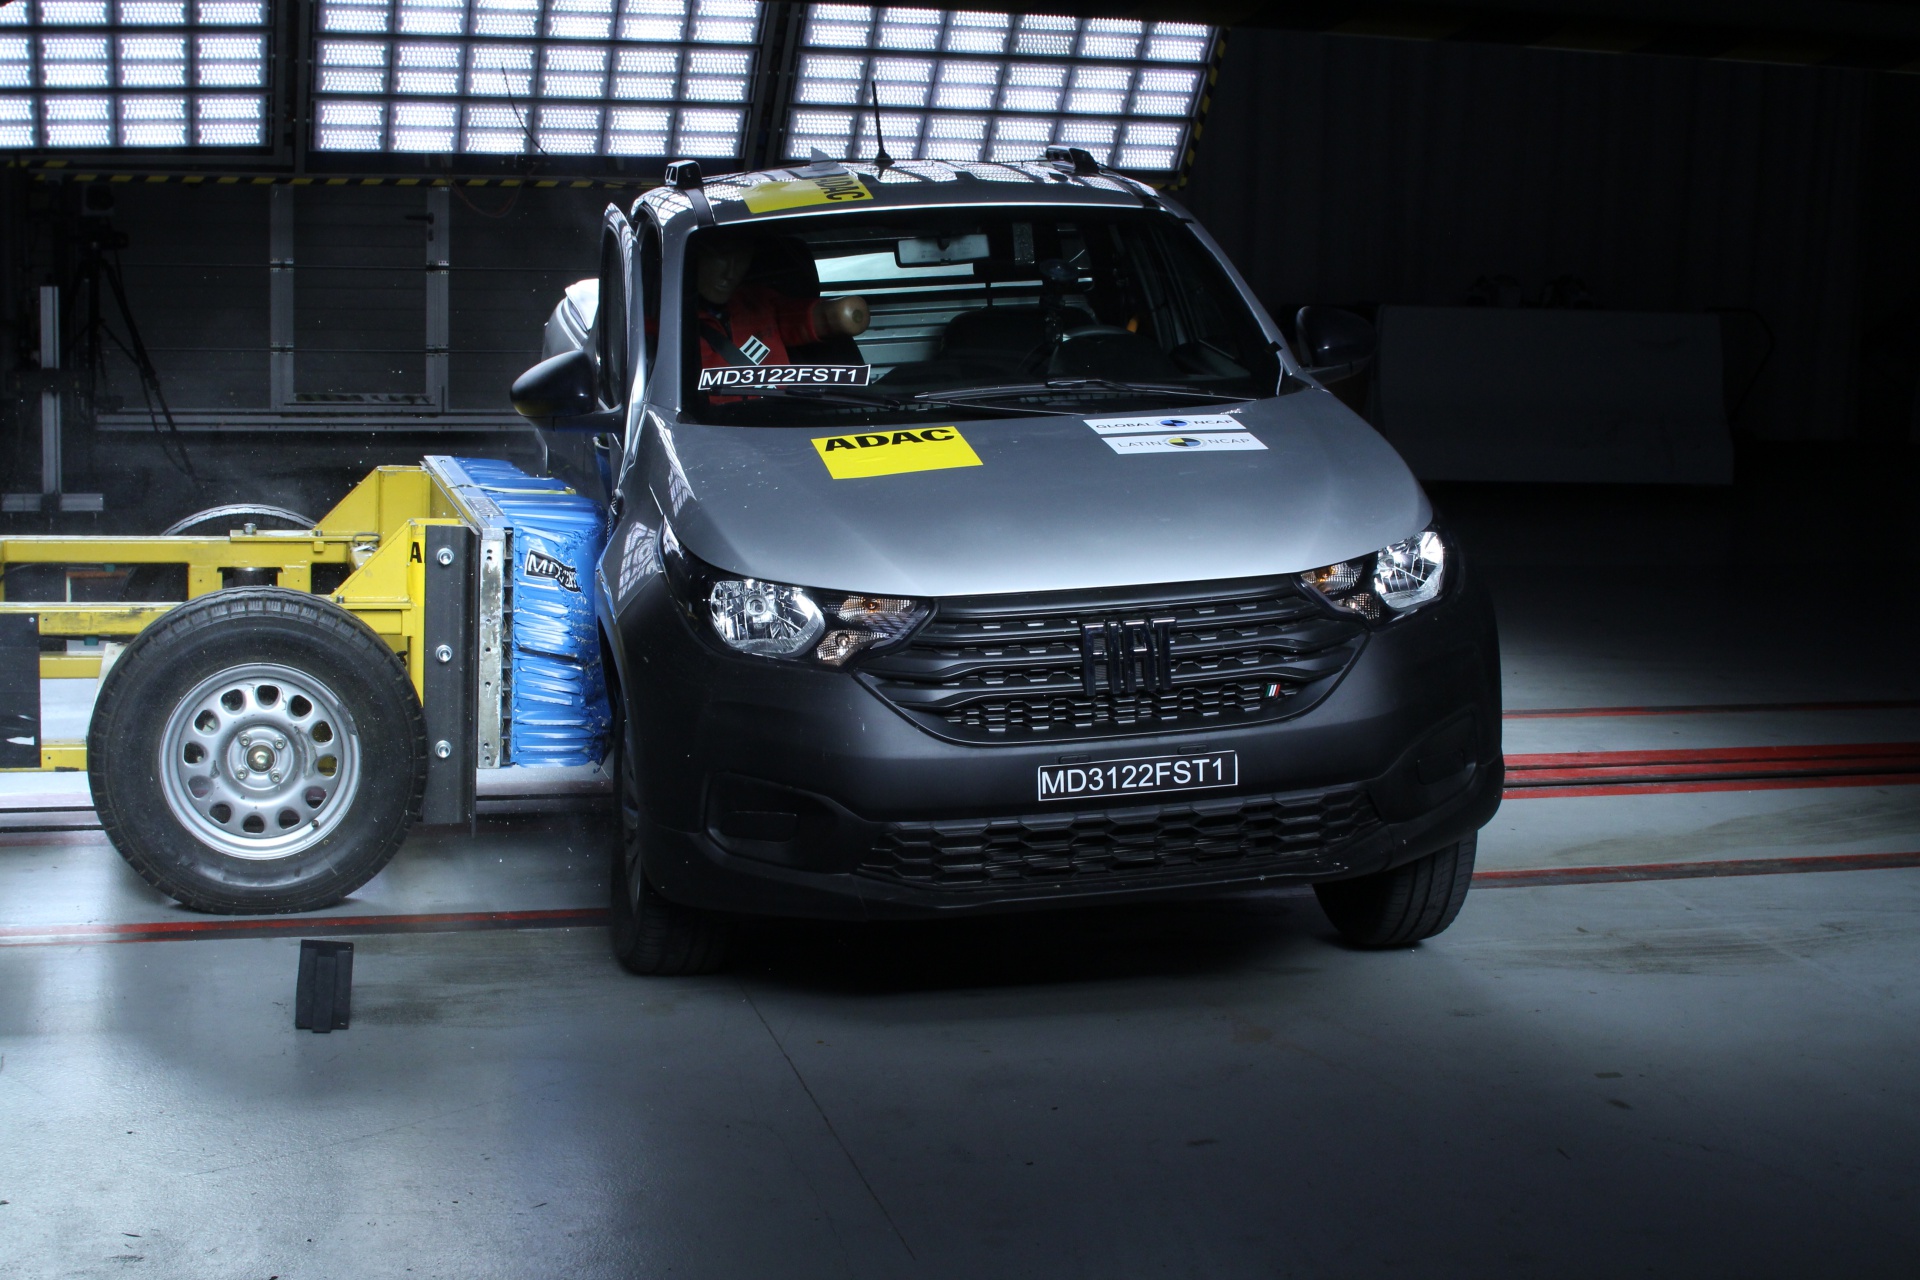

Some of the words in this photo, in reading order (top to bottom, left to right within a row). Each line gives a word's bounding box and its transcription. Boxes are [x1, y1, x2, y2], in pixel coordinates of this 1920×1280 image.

[702, 368, 857, 386] MD3122FST1
[825, 429, 955, 452] ADAC
[410, 541, 423, 563] A
[1082, 617, 1176, 696] FIAT
[1041, 757, 1223, 795] MD3122FST1
